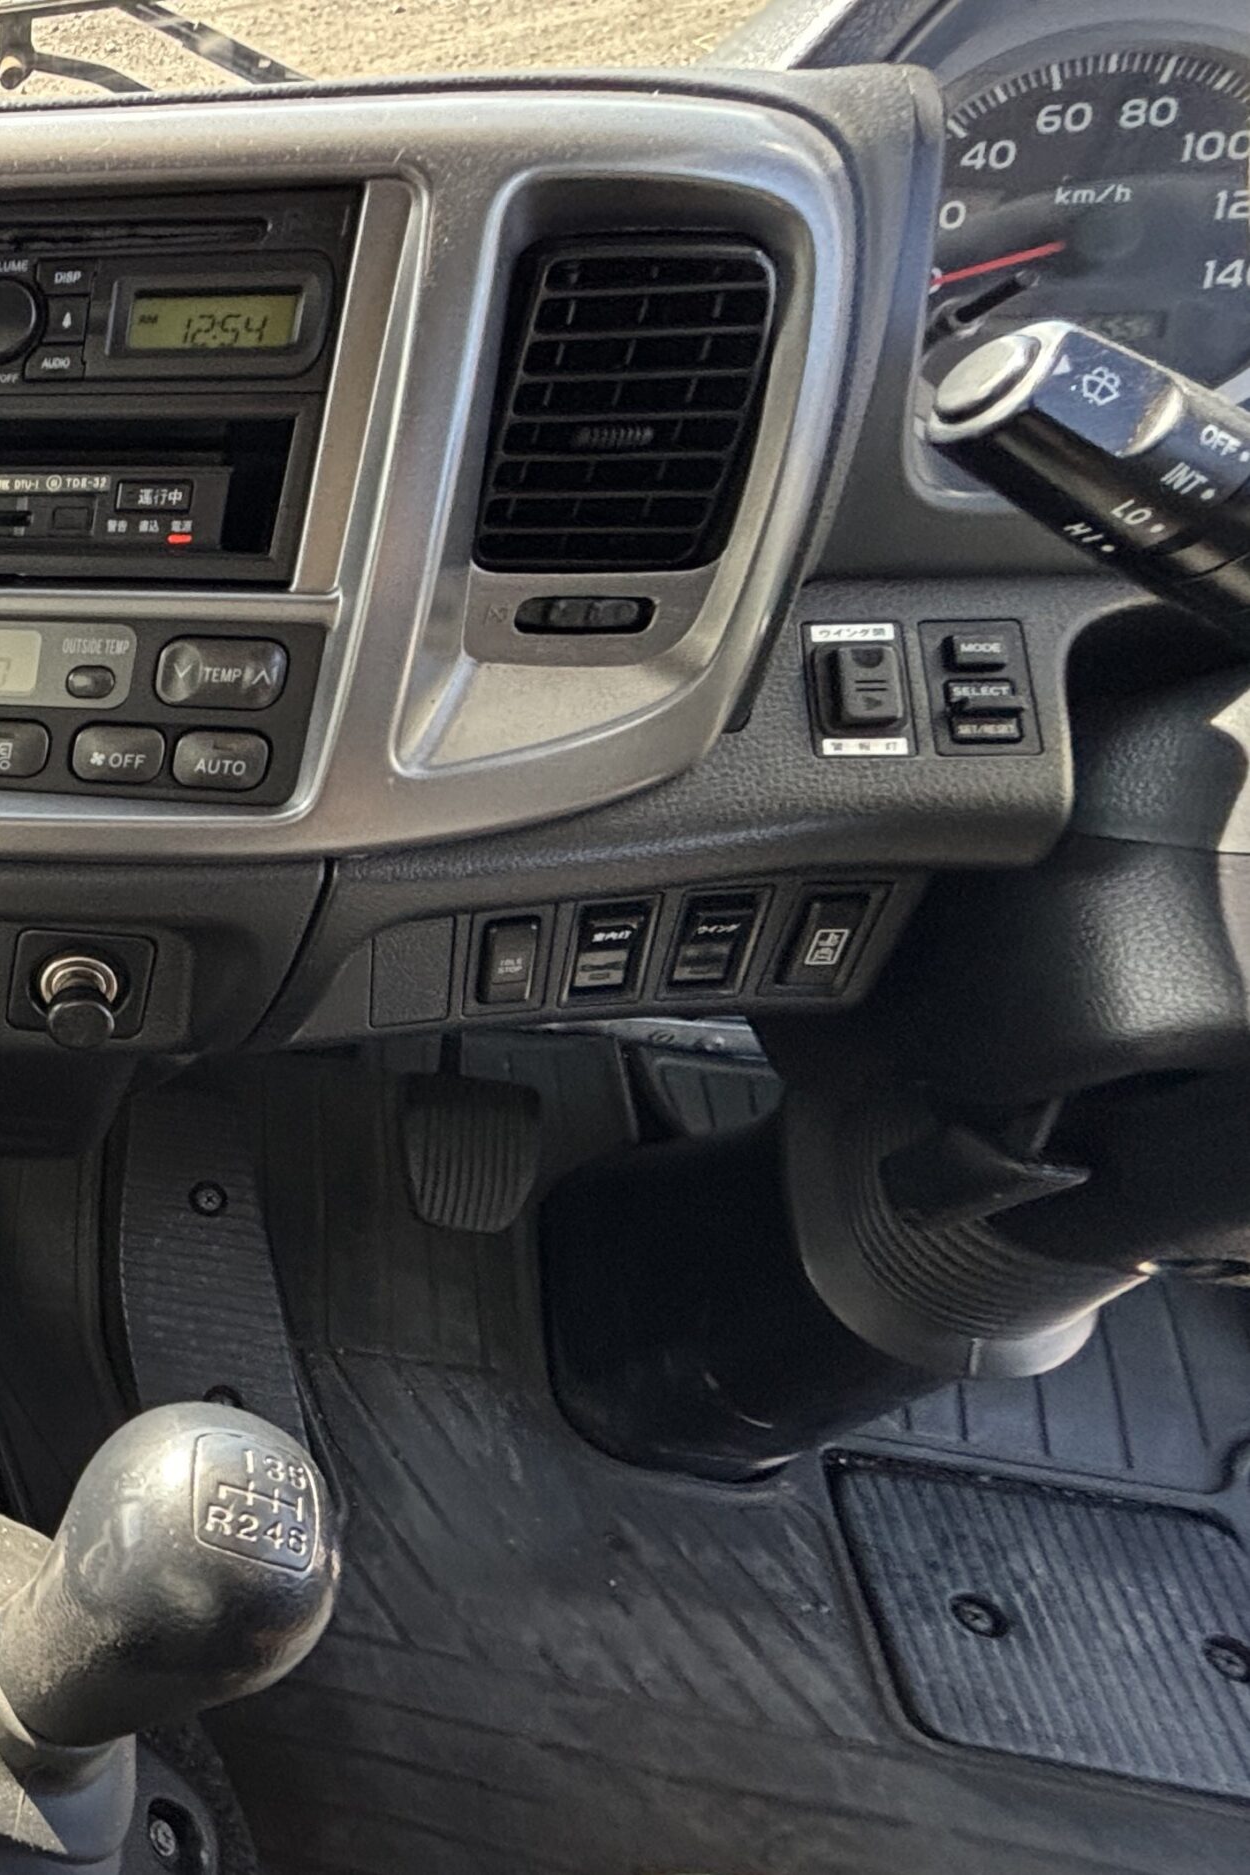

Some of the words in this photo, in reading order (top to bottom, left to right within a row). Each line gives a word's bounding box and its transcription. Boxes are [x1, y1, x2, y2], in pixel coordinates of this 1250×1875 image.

[1036, 102, 1093, 134] 60
[1119, 96, 1179, 129] 80
[960, 139, 1017, 170] 40
[1180, 130, 1250, 162] 100
[1054, 183, 1132, 205] km/h
[1213, 190, 1250, 220] 12
[939, 200, 966, 230] 0
[54, 271, 83, 284] DISP
[1202, 259, 1250, 289] 14
[183, 314, 268, 345] 12:54
[41, 357, 71, 369] AUDIO
[1201, 424, 1241, 456] OFF
[1160, 462, 1208, 495] INT
[138, 489, 183, 506] 運行中
[1110, 499, 1152, 525] LO
[1063, 522, 1104, 543] HI
[62, 639, 103, 654] OUTSIDE
[105, 640, 130, 655] TEMP
[960, 643, 1001, 653] MODE
[204, 667, 241, 683] TEMP
[952, 685, 1010, 697] SELECT
[109, 753, 146, 769] OFF
[194, 757, 246, 775] AUTO
[498, 966, 523, 974] STOP
